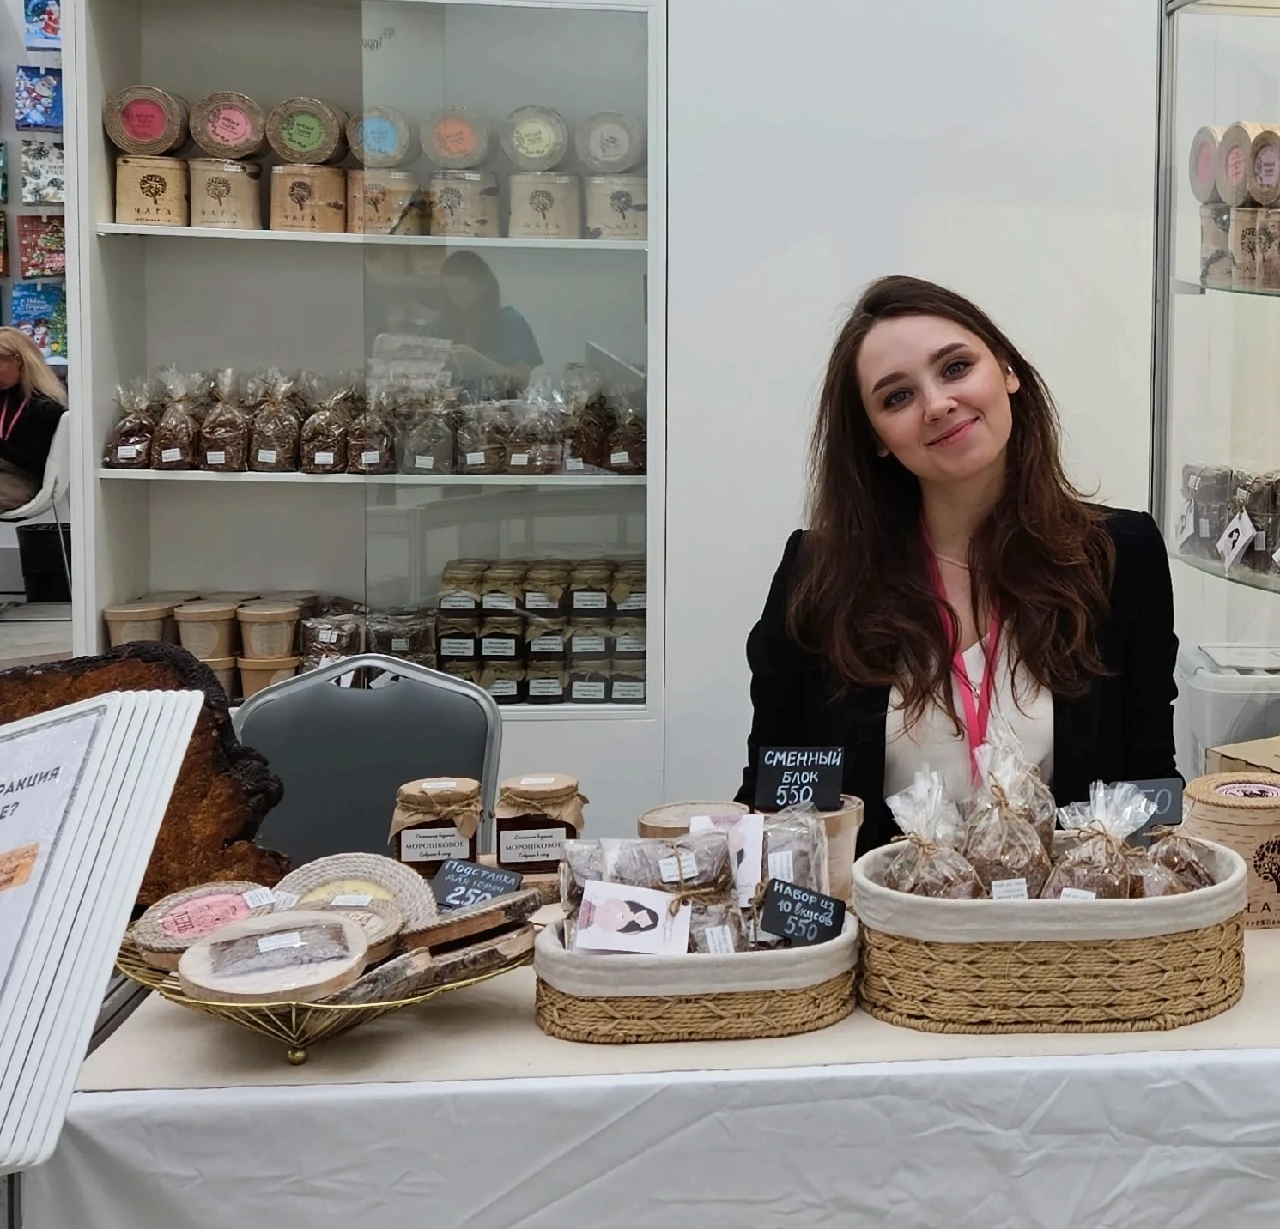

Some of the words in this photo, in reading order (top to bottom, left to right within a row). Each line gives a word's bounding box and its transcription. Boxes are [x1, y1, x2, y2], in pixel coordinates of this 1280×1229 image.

[764, 747, 844, 768] СМЕННЫЙ
[782, 771, 818, 784] БЛОК
[775, 785, 813, 806] 550
[773, 881, 817, 905] НАБОР
[777, 900, 793, 913] 10
[784, 916, 818, 941] 550
